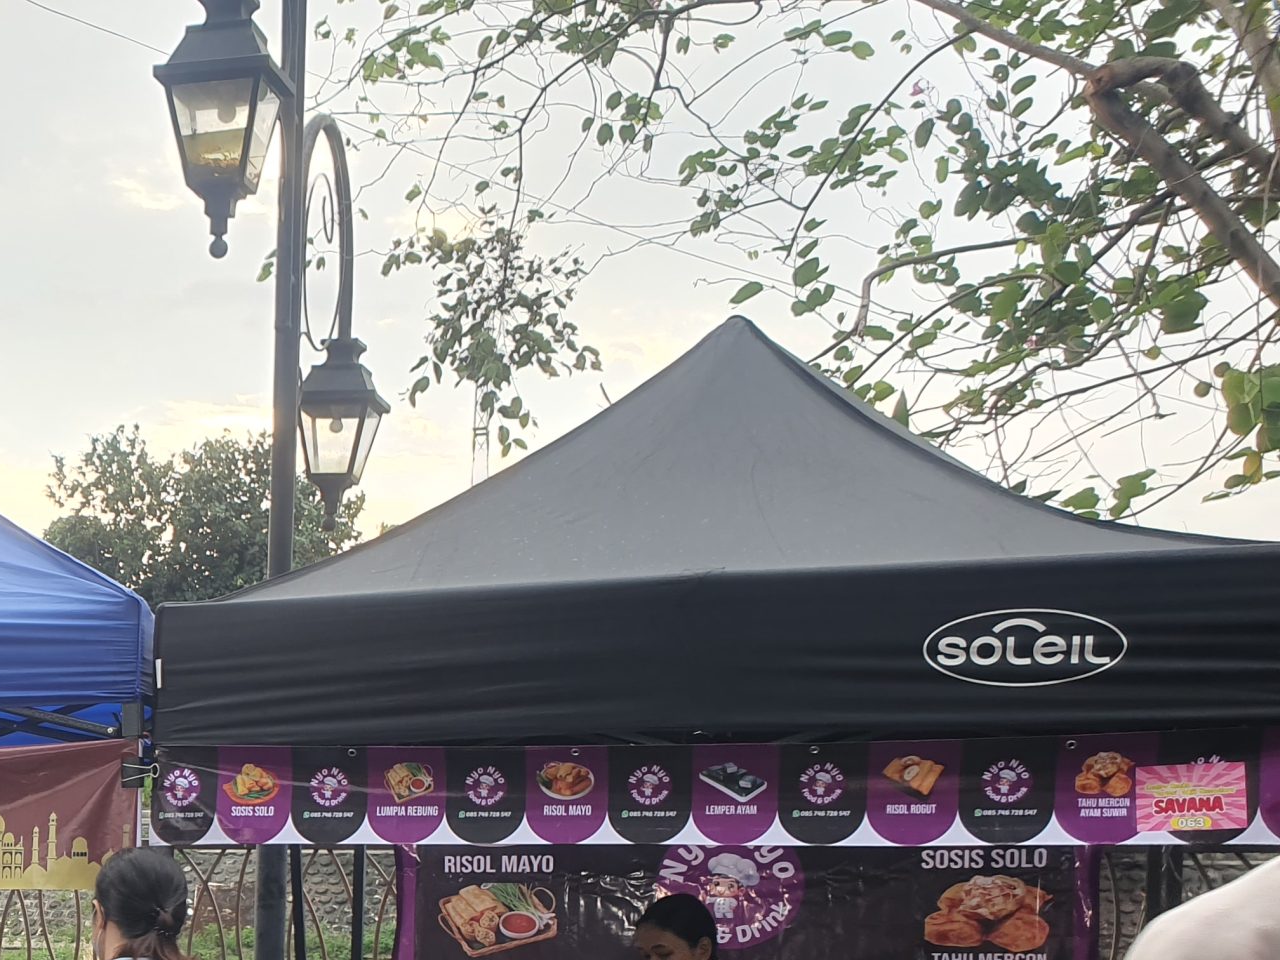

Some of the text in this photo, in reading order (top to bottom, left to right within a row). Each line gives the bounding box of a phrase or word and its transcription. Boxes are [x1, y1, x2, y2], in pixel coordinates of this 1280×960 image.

[465, 766, 505, 785] Nyo Nyo
[628, 764, 670, 784] Nyo Nyo
[799, 762, 844, 783] Nyo Nyo
[981, 758, 1029, 781] Nyo Nyo
[544, 804, 592, 816] RISOL MAYO
[706, 805, 757, 815] LEMPER AYAM
[886, 804, 909, 814] RISOL
[1078, 798, 1130, 807] TAHU MERCON
[1153, 796, 1224, 815] SAVANA
[231, 806, 274, 816] SOSIS SOLO
[376, 806, 438, 816] LUMPIA REBUNG
[1080, 808, 1127, 817] AYAM SUWIR
[1178, 818, 1204, 828] 063
[444, 854, 554, 873] RISOL MAYO
[921, 848, 1048, 869] SOSIS SOLO
[736, 901, 792, 943] Drink
